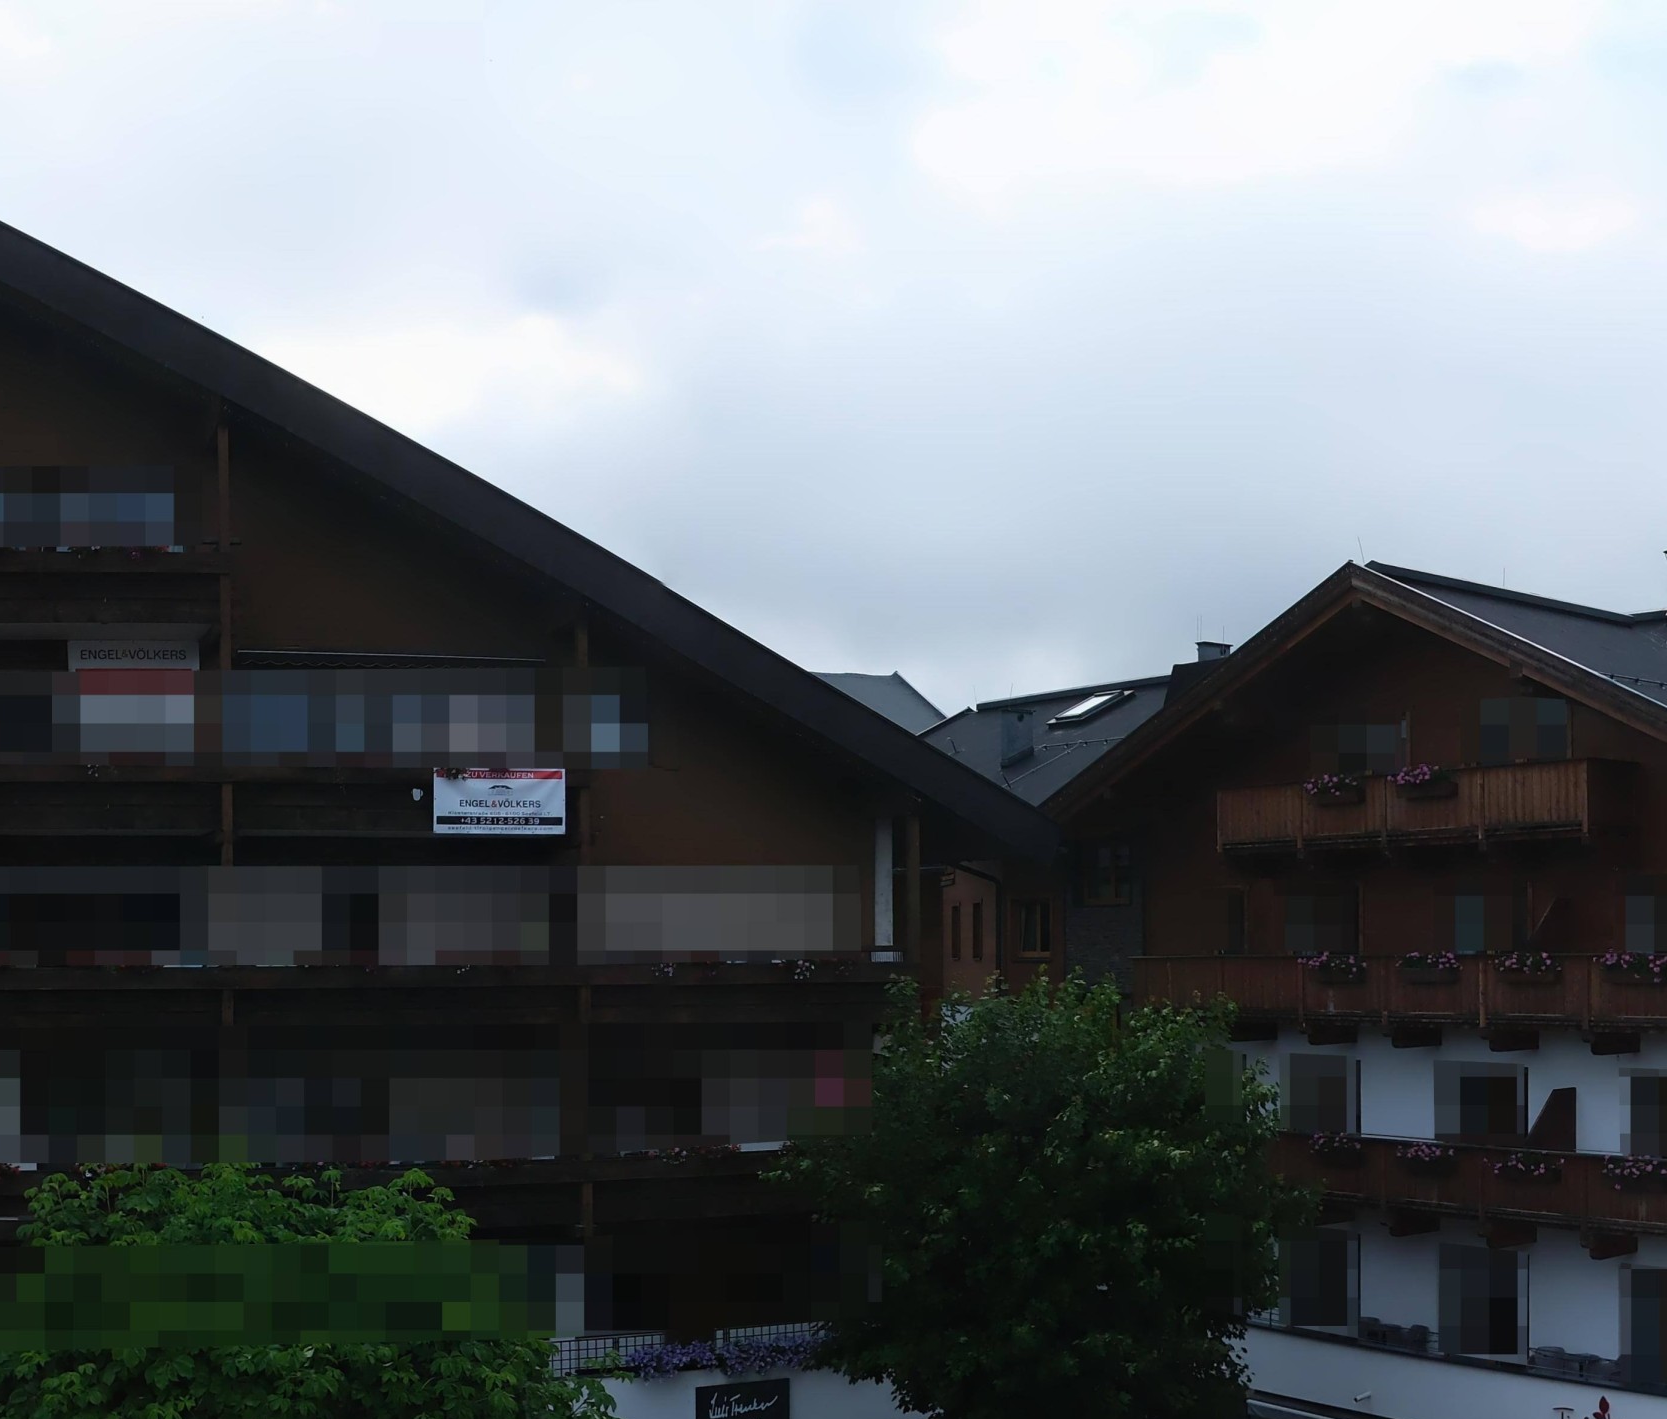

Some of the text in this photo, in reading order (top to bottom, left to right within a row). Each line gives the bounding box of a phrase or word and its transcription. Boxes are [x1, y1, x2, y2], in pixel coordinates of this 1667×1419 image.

[80, 647, 187, 660] ENGEL&VÖLKERS
[467, 770, 534, 779] ZU VERKAUFEN
[459, 798, 541, 809] ENGEL&VÖLKERS
[461, 817, 540, 825] +43 5212-526 39
